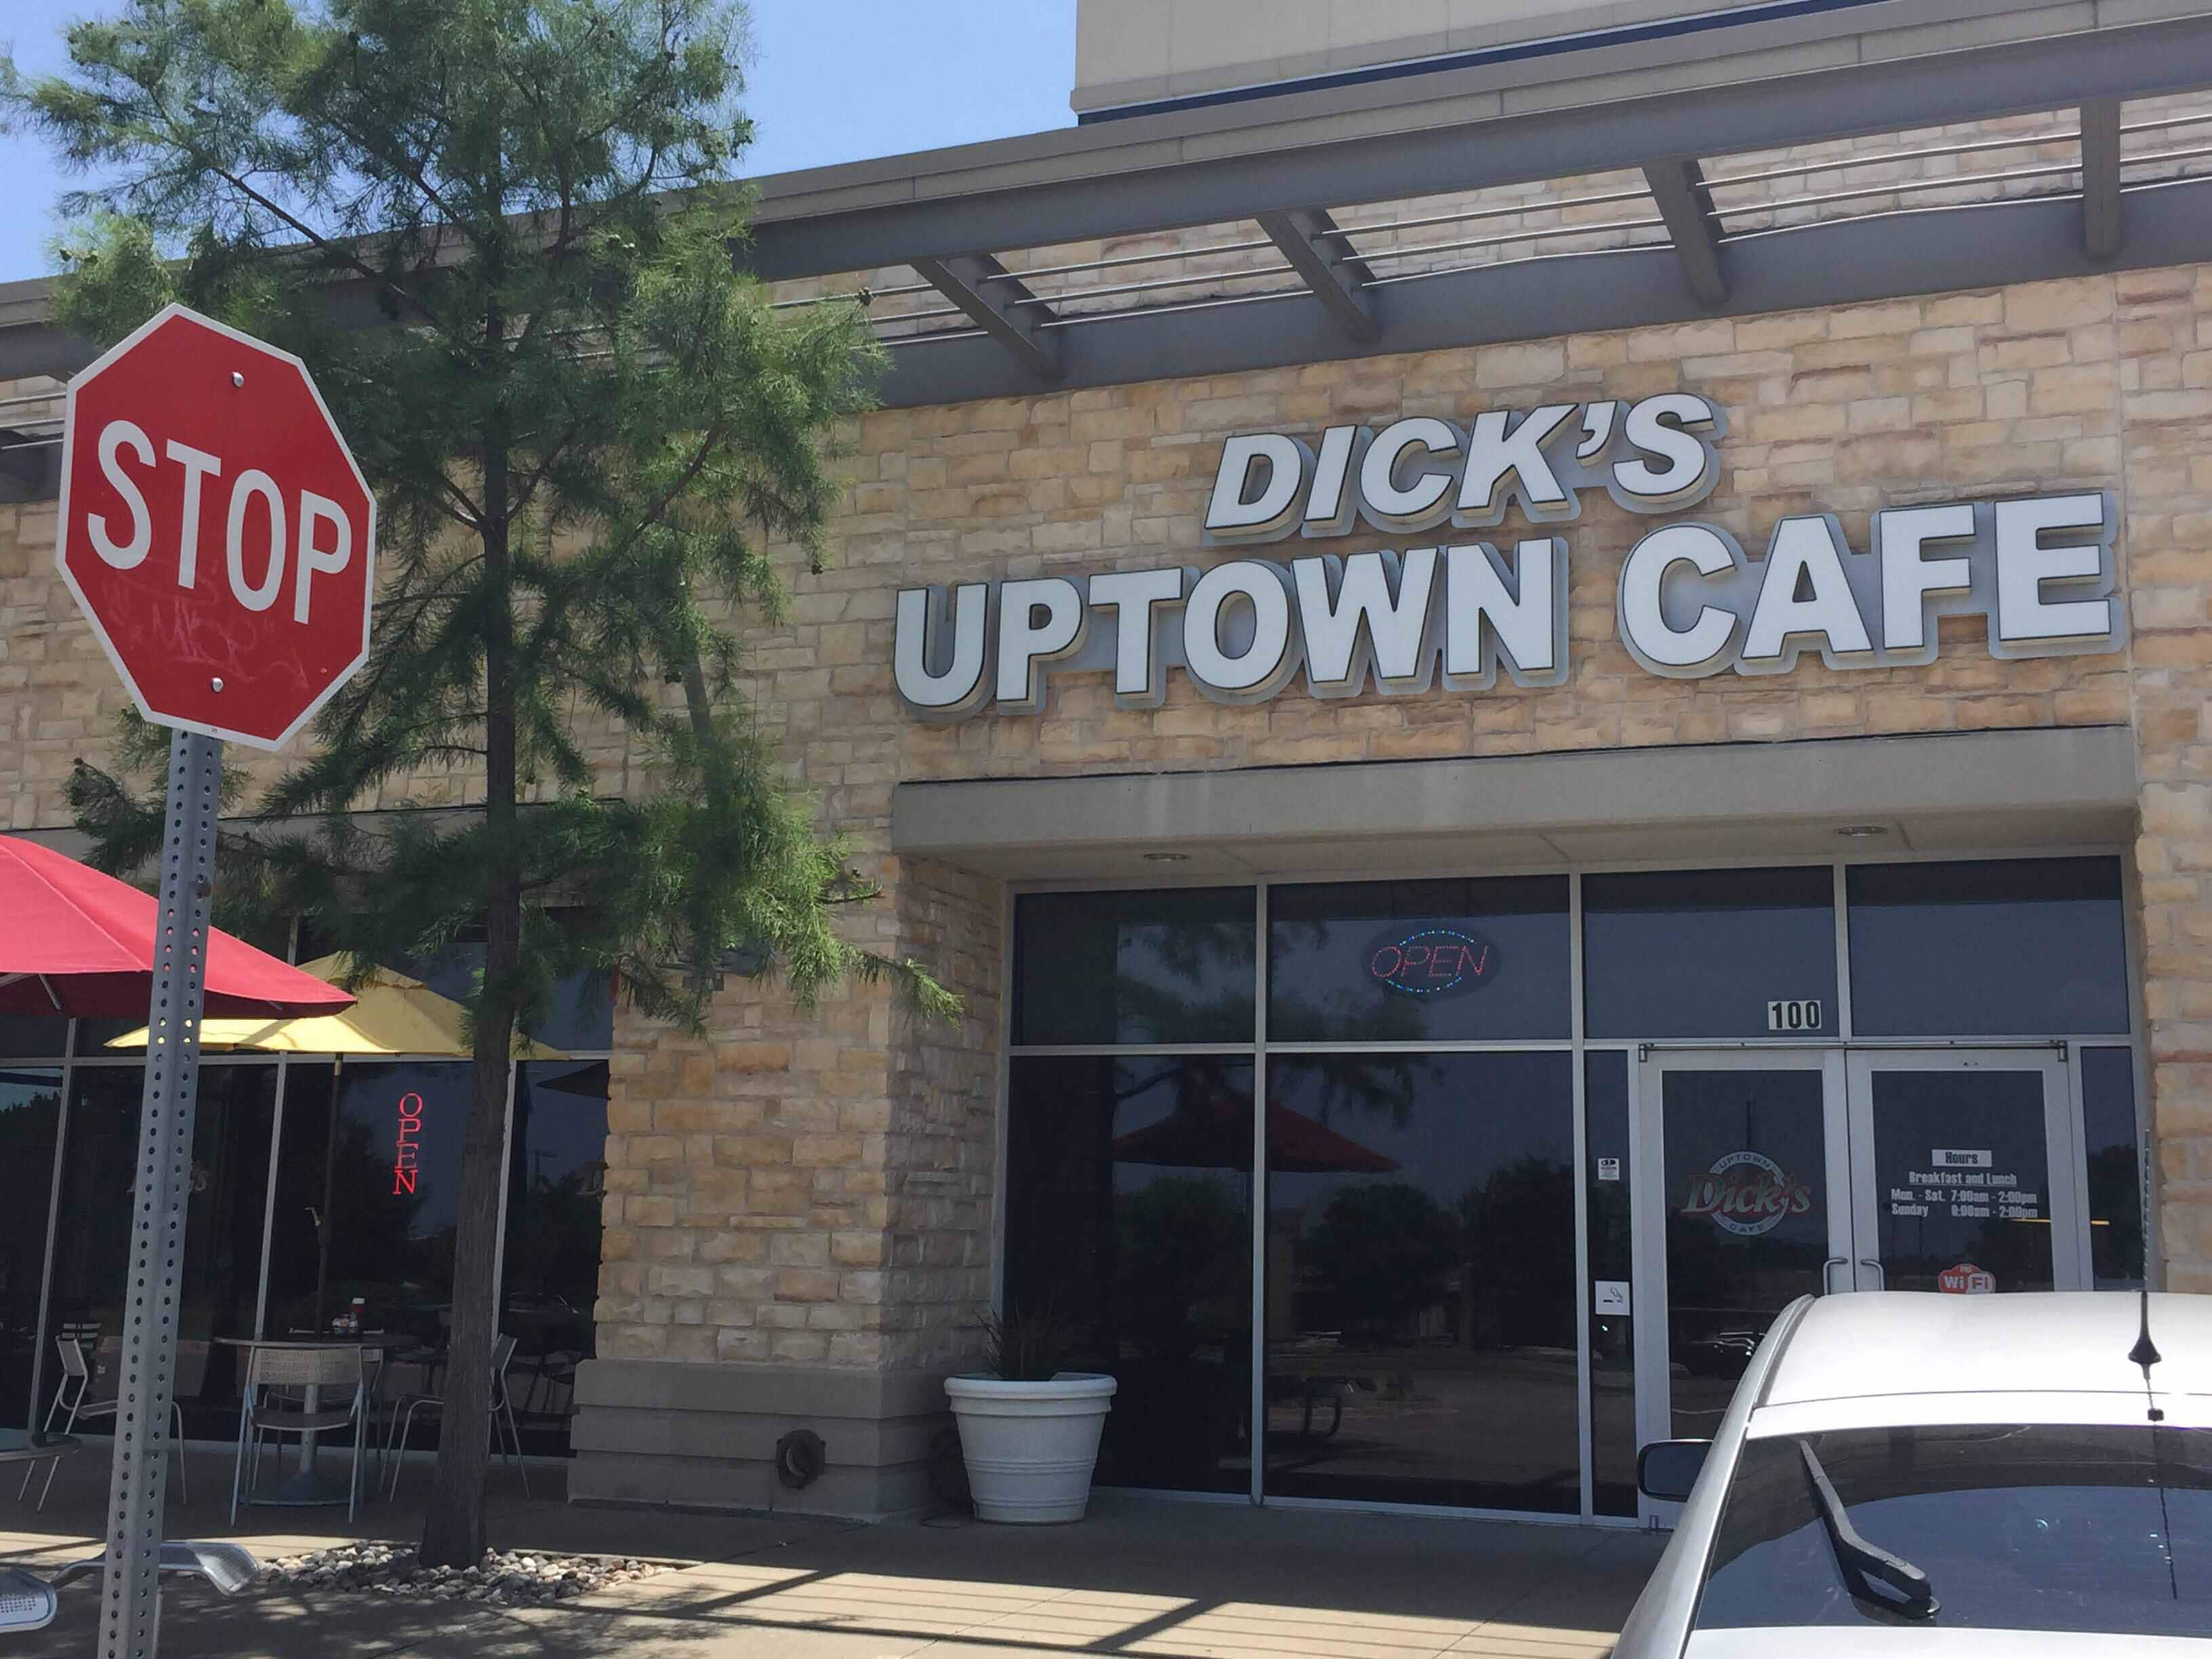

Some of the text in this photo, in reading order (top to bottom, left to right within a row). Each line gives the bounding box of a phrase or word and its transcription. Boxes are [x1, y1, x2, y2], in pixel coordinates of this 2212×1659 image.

[1204, 392, 1716, 530] DICK'S
[87, 420, 352, 625] STOP
[893, 492, 2112, 708] UPTOWN CAFE
[1371, 945, 1488, 977] OPEN
[1772, 1002, 1820, 1028] 100
[393, 1092, 423, 1195] OPEN
[1719, 1153, 1772, 1168] UPTOWN
[1945, 1151, 1978, 1164] Hours
[1908, 1171, 2018, 1186] Breakfast and Lunch
[1891, 1188, 1916, 1201] Mon.
[1925, 1189, 1946, 1202] Sat.
[1951, 1189, 1989, 1203] 7:00am
[1999, 1191, 2037, 1205] 2:00pm
[1891, 1203, 1929, 1218] Sunday
[1999, 1206, 2039, 1220] 2:00pm
